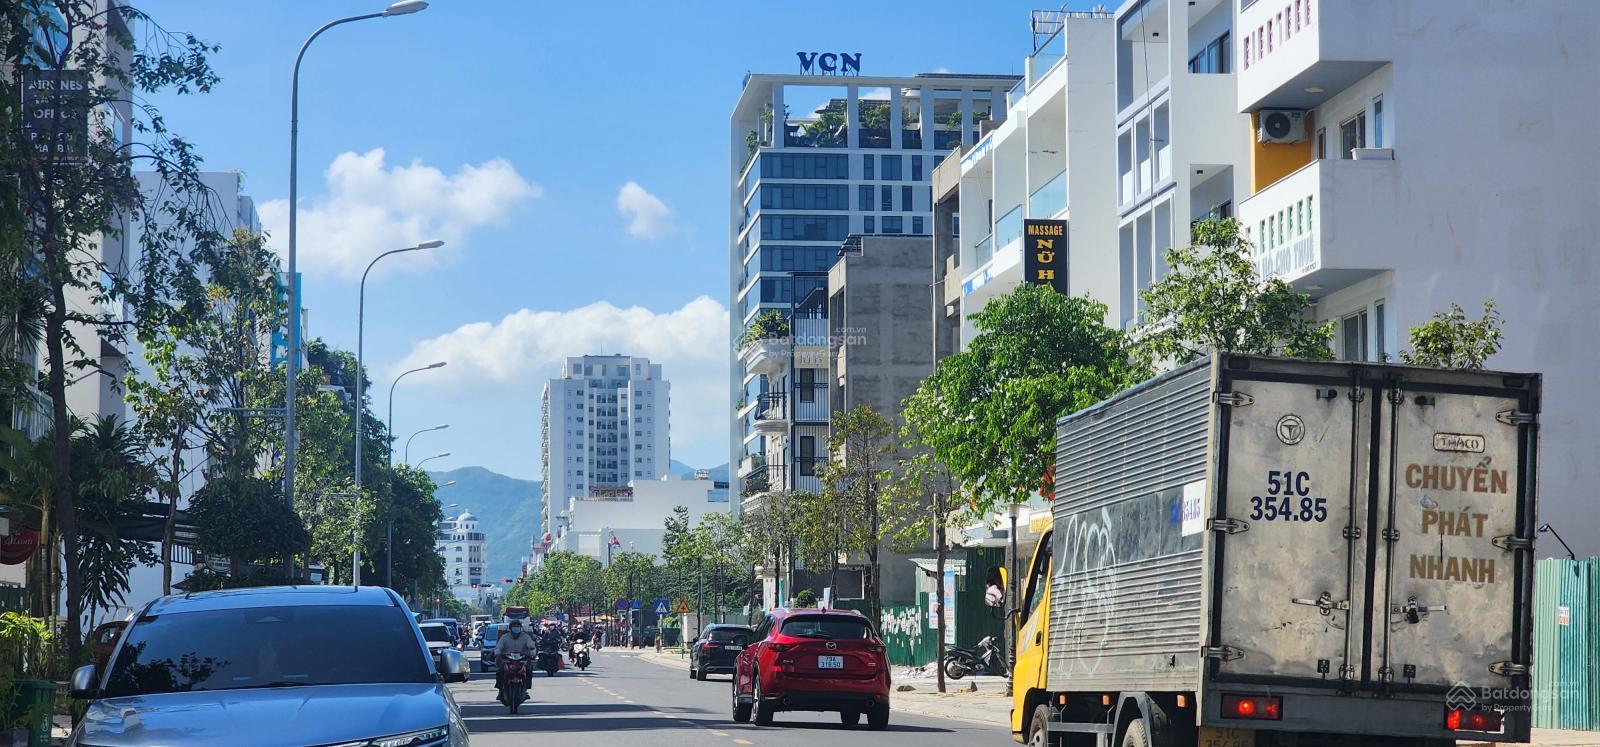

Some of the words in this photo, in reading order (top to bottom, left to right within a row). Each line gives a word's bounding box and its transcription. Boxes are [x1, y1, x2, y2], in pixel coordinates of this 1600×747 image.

[796, 51, 862, 72] VCN
[1027, 224, 1063, 236] MASSAGE
[1037, 239, 1055, 264] NỮ
[1038, 269, 1054, 289] H
[1440, 437, 1480, 449] THACO
[1267, 470, 1310, 496] 51C
[1405, 456, 1507, 494] CHUYỂN
[1249, 496, 1328, 522] 354.85
[1422, 505, 1488, 538] PHÁT
[1409, 554, 1495, 584] NHANH
[1205, 739, 1250, 747] 35485
[1216, 727, 1241, 739] 51C
